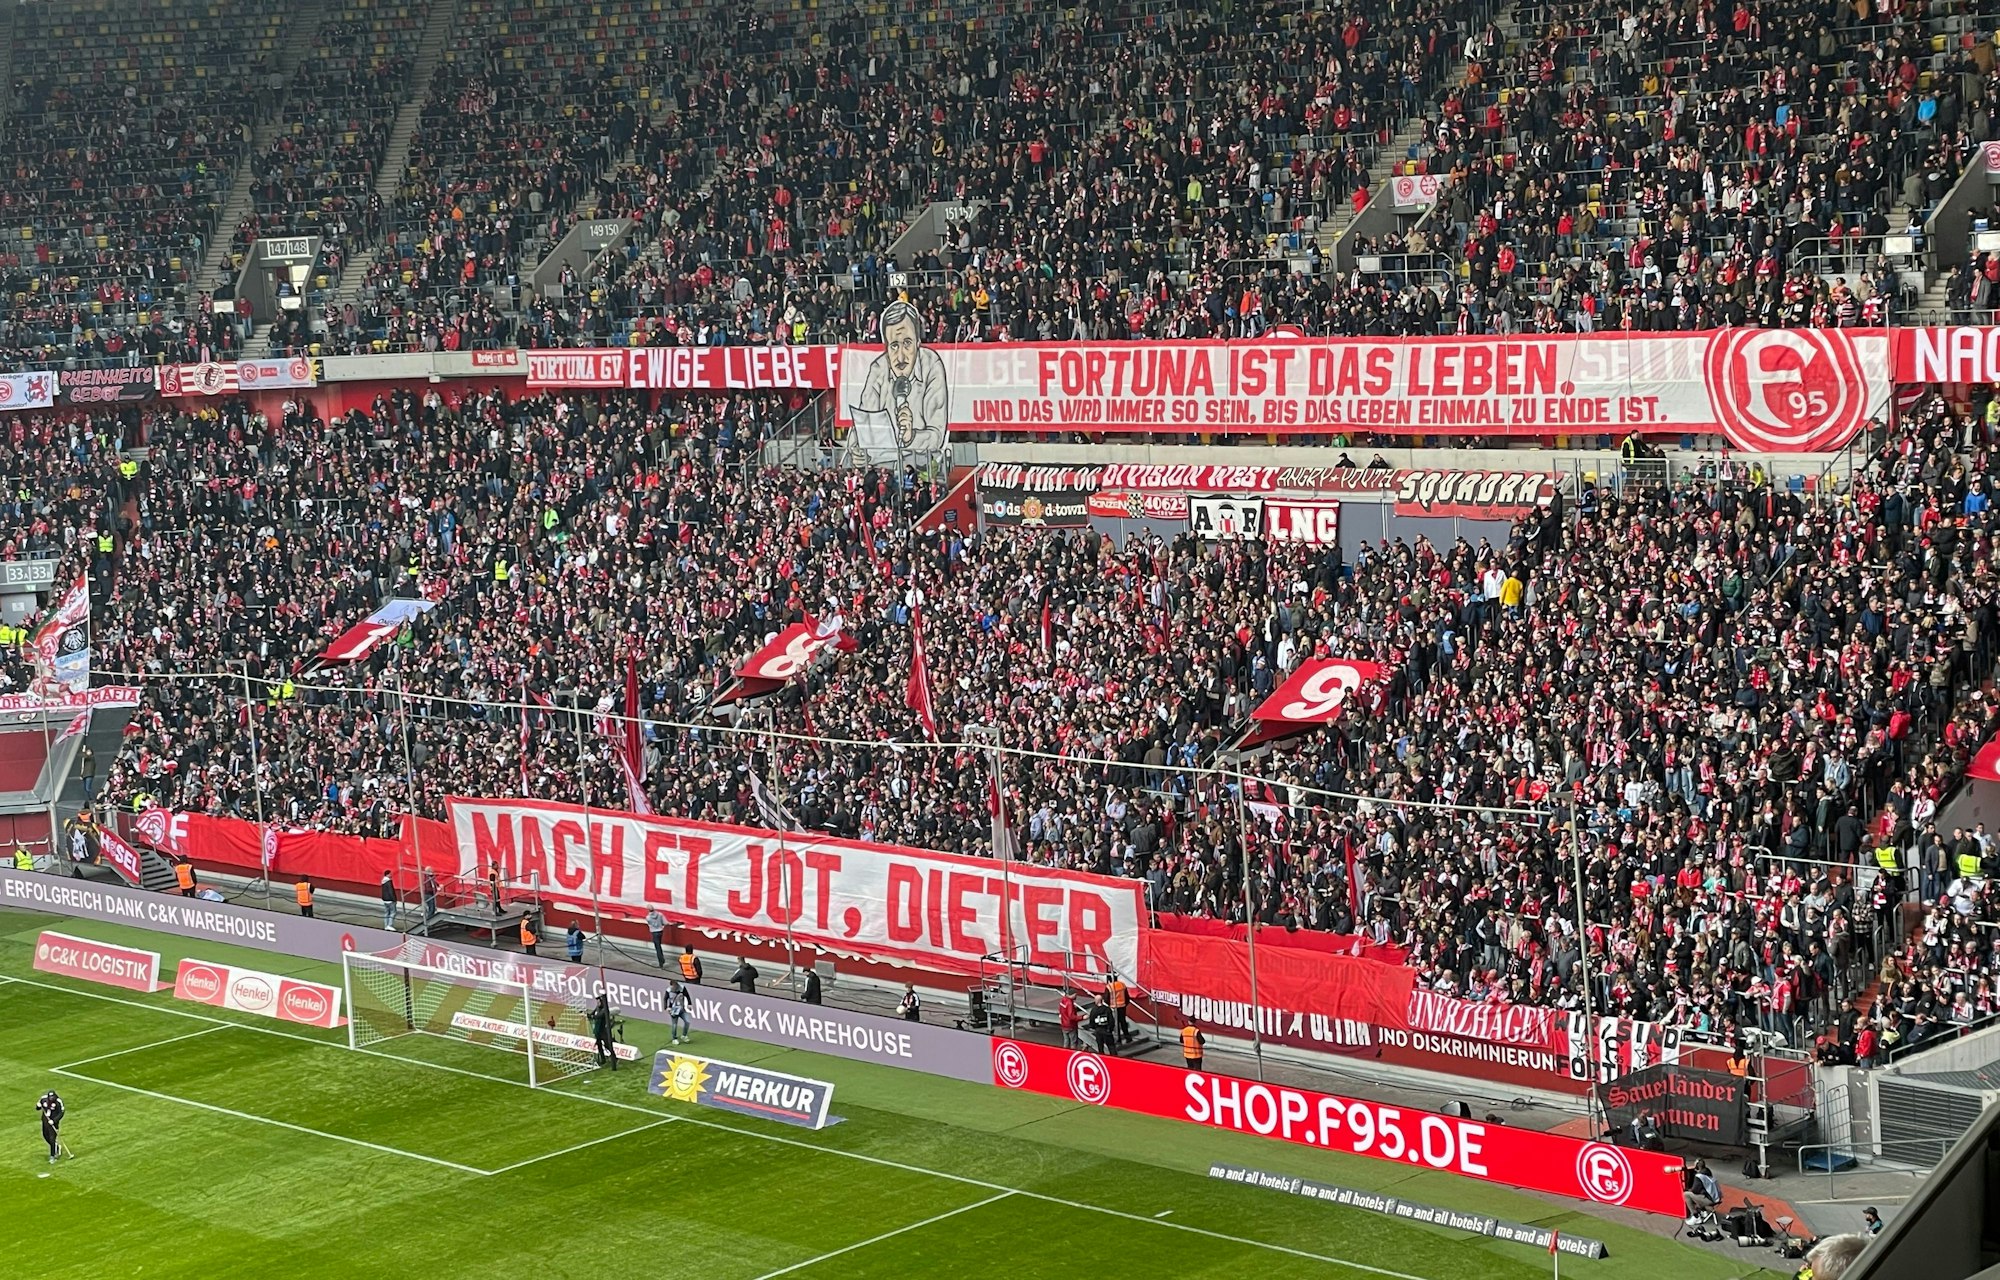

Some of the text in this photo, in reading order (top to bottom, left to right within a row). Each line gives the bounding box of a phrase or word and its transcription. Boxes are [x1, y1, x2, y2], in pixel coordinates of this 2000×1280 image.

[945, 207, 958, 220] 151
[590, 224, 619, 237] 149 150
[270, 241, 307, 255] 147 148
[527, 355, 595, 380] FORTUNA
[629, 347, 711, 388] EWIGE
[724, 347, 813, 389] LIEBE
[1039, 344, 1575, 397] FORTUNA IST DAS LEBEN.
[973, 396, 1669, 425] UND DAS WIRD IMMER SO SEIN, BIS DAS LEBEN EINMAL ZU ENDE IST.
[1788, 390, 1829, 420] 95
[1102, 464, 1282, 489] DIVISION WEST
[1088, 496, 1127, 511] BONZEN
[1144, 496, 1187, 511] 40625
[1398, 470, 1547, 511] SQUADRA
[1194, 505, 1213, 530] A
[1268, 508, 1337, 543] LNC
[89, 688, 138, 703] MAFIA
[1281, 665, 1361, 719] 9
[471, 811, 1112, 973] MACH ET JOT, DIETER
[5, 878, 277, 942] ERFOLGREICH DANK C&K WAREHOUSE
[50, 945, 148, 982] C&K LOGISTIK
[186, 973, 219, 992] Henkel
[234, 983, 270, 1002] Henkel
[287, 993, 324, 1013] Henkel
[425, 950, 527, 985] LOGISTISCH
[532, 968, 662, 1009] ERFOLGREICH
[729, 1003, 772, 1033] C&K
[777, 1012, 913, 1058] WAREHOUSE
[454, 1014, 481, 1029] KÜCHEN
[482, 1021, 509, 1034] AKTUELL
[541, 1032, 569, 1046] AKTUELL
[714, 1070, 815, 1113] MERKUR
[1088, 1084, 1100, 1095] 95
[1184, 1072, 1489, 1177] SHOP.F95.DE
[1209, 1165, 1290, 1191] me and all hotels
[1604, 1180, 1619, 1192] 95
[1301, 1184, 1384, 1211] me and all hotels
[1396, 1203, 1483, 1232] me and all hotels
[1496, 1224, 1512, 1238] me
[1514, 1228, 1536, 1244] and
[1536, 1231, 1551, 1247] all
